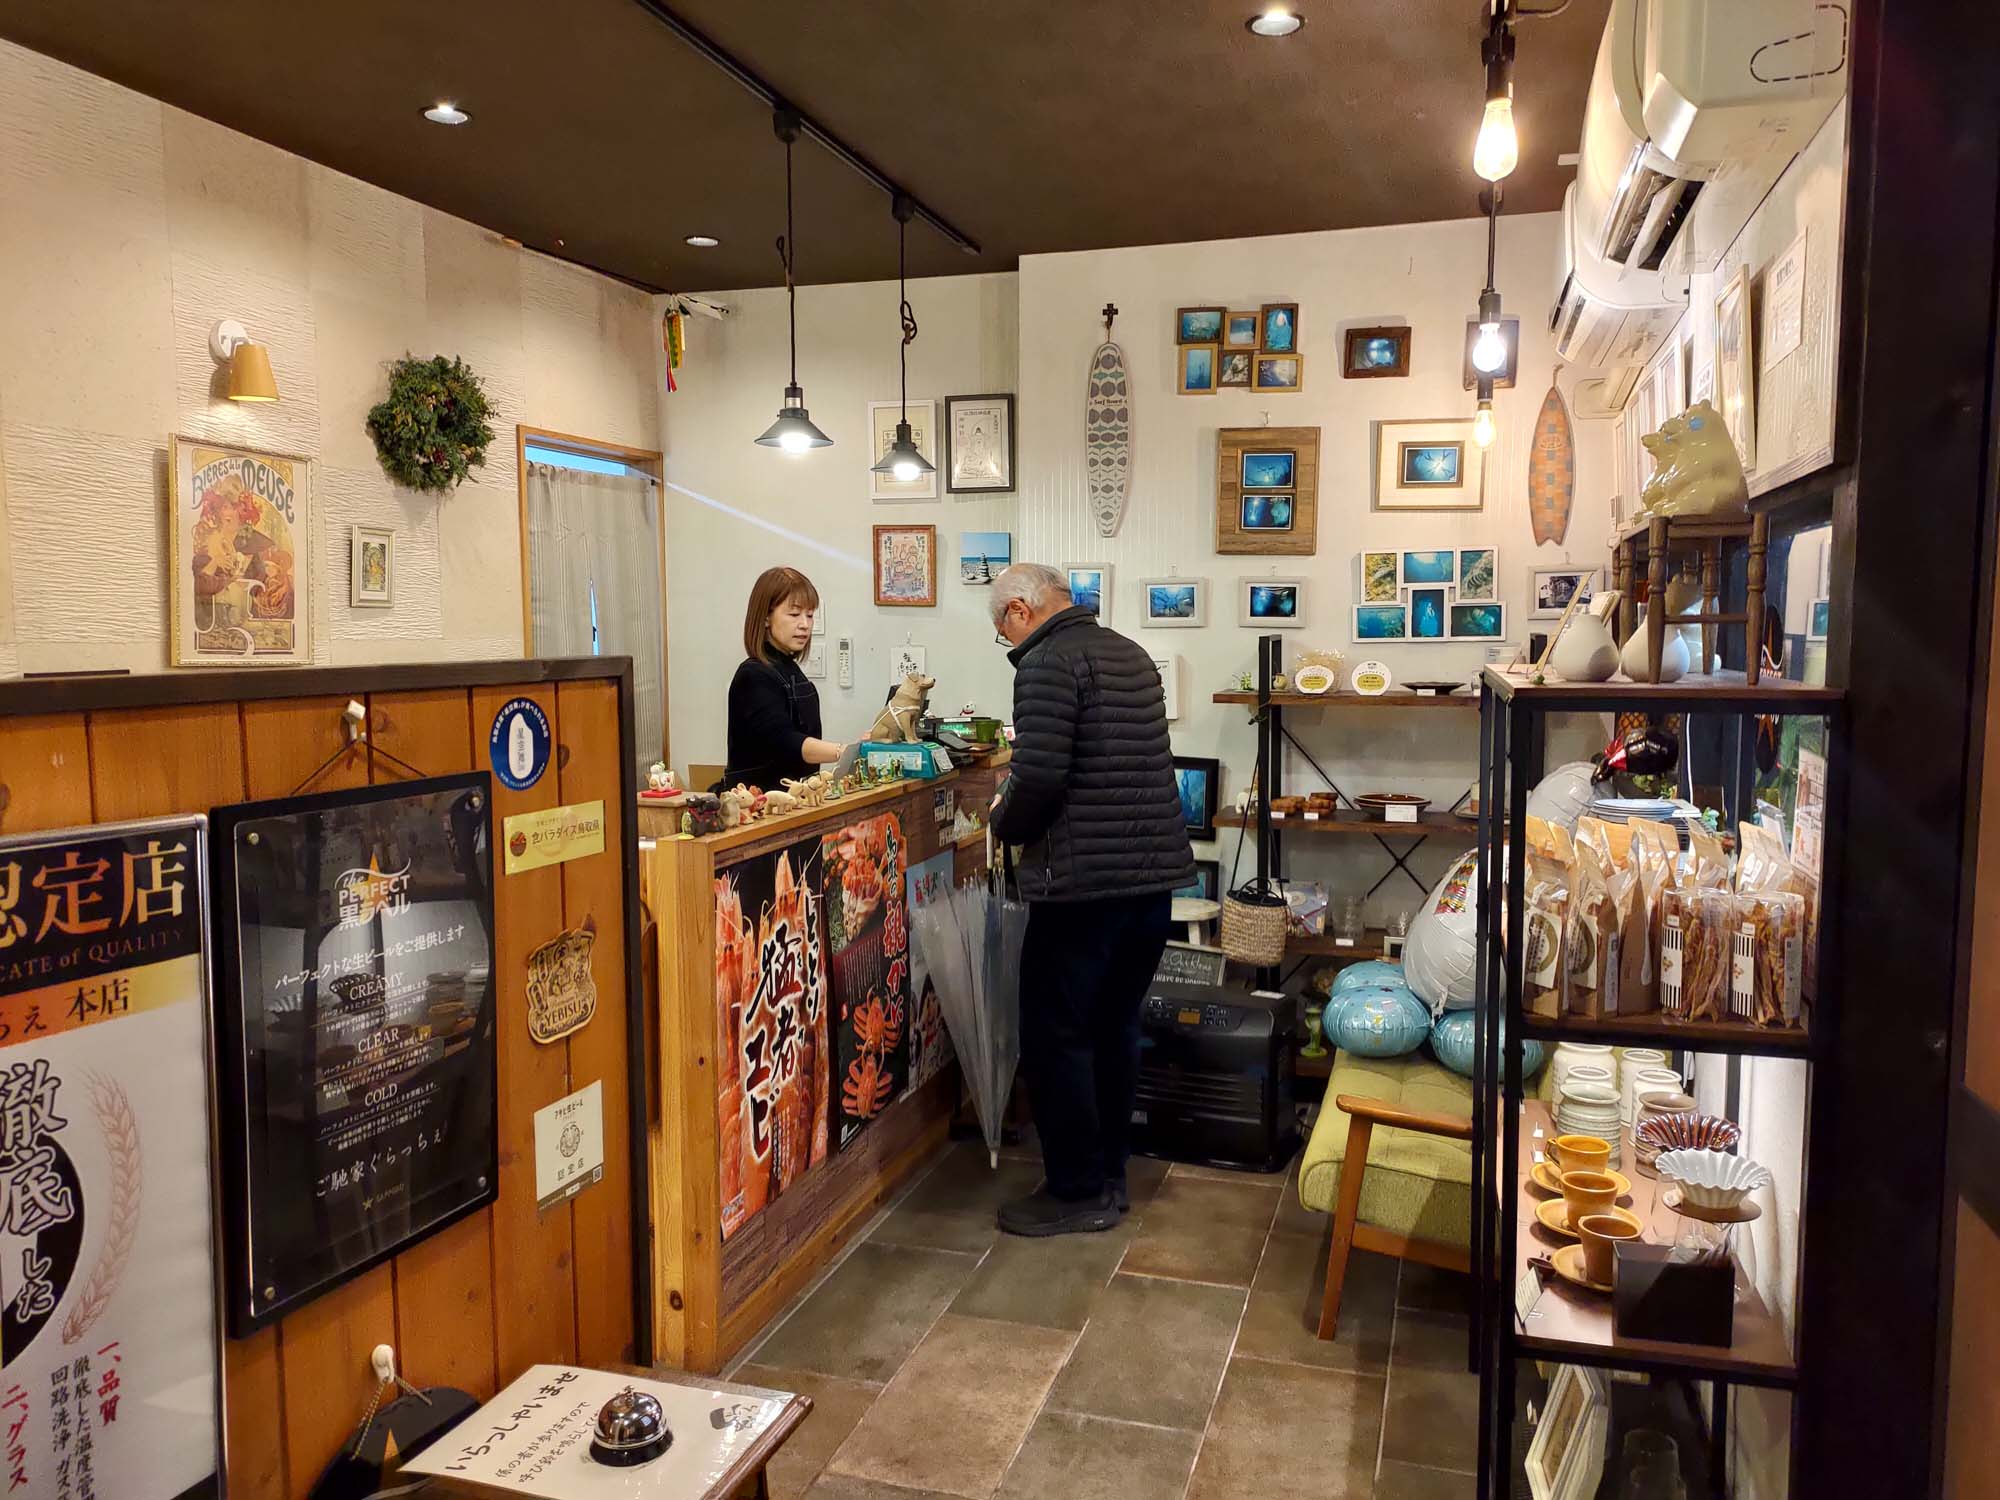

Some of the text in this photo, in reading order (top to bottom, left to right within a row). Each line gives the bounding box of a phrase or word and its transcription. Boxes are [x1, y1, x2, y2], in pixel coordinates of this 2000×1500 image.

[240, 459, 295, 524] MEUSE
[338, 874, 412, 906] PERFECT
[338, 892, 411, 932] 黒ラベル
[59, 949, 80, 968] of
[87, 928, 186, 964] QUALITY
[274, 924, 465, 990] パーフェクトな生ビールをご提供します
[804, 894, 820, 1022] とっとり
[65, 977, 131, 1022] 本店
[349, 972, 404, 1002] CREAMY
[544, 999, 583, 1027] YEBISU
[358, 1026, 400, 1054] CLEAR
[364, 1083, 399, 1107] COLD
[0, 1058, 74, 1324] 徹底した
[96, 1341, 122, 1427] 一、品質
[0, 1384, 29, 1494] 二、グラス
[495, 1401, 591, 1478] 係の者が参りますので
